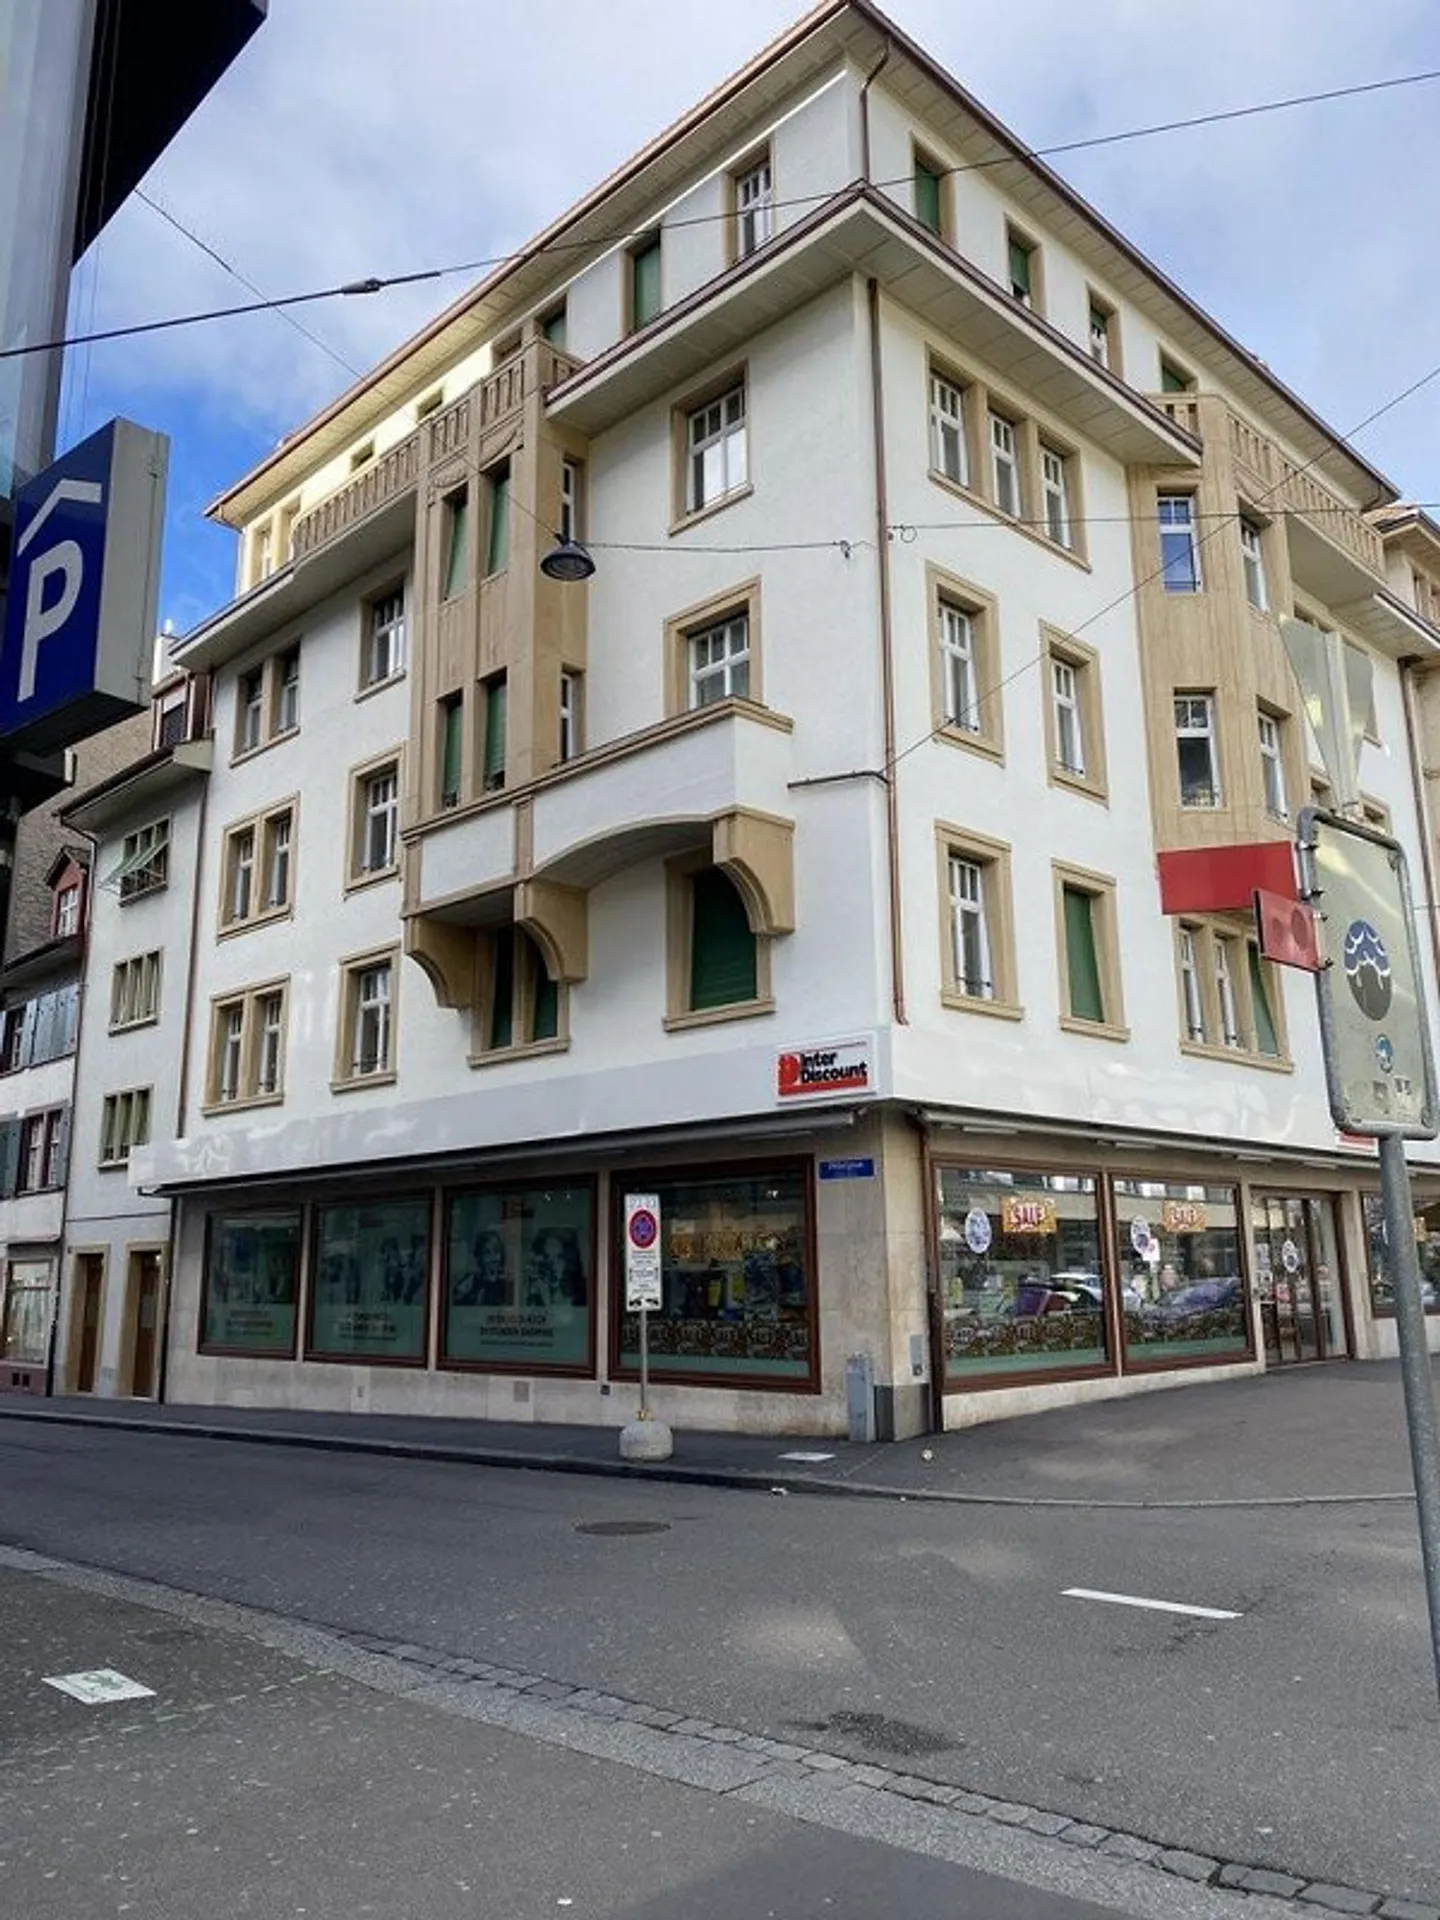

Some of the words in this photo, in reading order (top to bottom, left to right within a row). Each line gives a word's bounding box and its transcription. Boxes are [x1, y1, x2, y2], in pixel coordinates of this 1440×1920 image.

[17, 539, 83, 703] P
[801, 1061, 867, 1084] Discount
[1012, 1203, 1045, 1224] SALE
